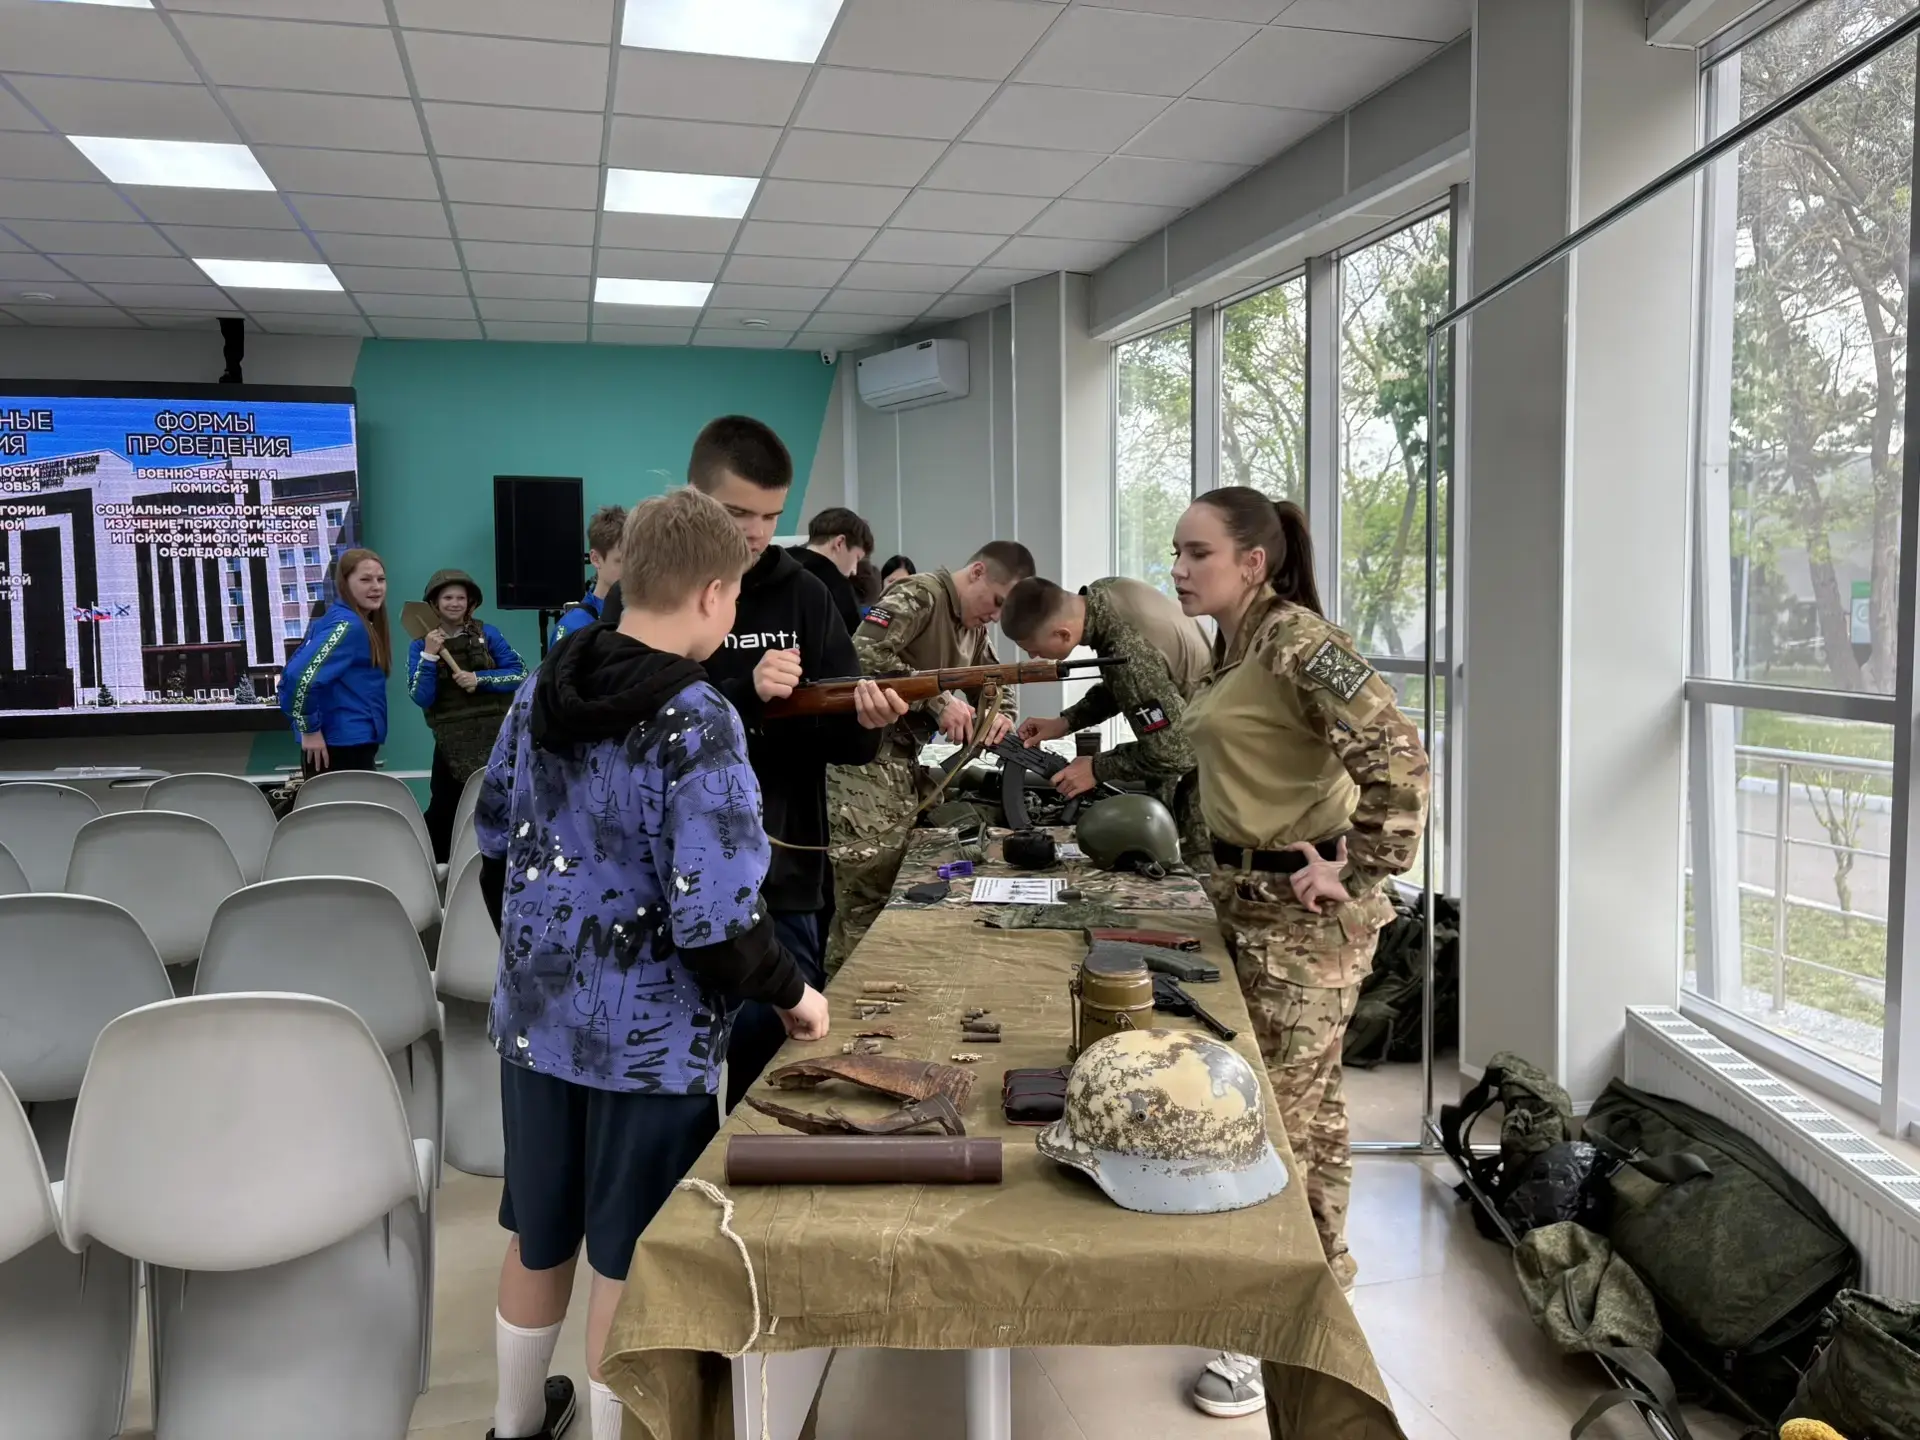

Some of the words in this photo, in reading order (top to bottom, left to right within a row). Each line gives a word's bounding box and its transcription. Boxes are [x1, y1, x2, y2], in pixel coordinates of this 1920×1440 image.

[156, 412, 255, 433] ФОРМЫ
[127, 434, 292, 458] ПРОВЕДЕНИЯ
[137, 468, 279, 480] ВОЕННО-ВРАЧЕБНАЯ
[172, 483, 250, 494] КОМИССИЯ
[95, 504, 322, 517] СОЦИАЛЬНО-ПСИХОЛОГИЧЕСКОЕ
[105, 519, 182, 531] ИЗУЧЕНИЕ,
[184, 519, 318, 531] ПСИХОЛОГИЧЕСКОЕ
[111, 533, 122, 544] И
[125, 532, 310, 545] ПСИХОФИЗИОЛОГИЧЕСКОЕ
[159, 547, 269, 559] ОБСЛЕДОВАНИЕ
